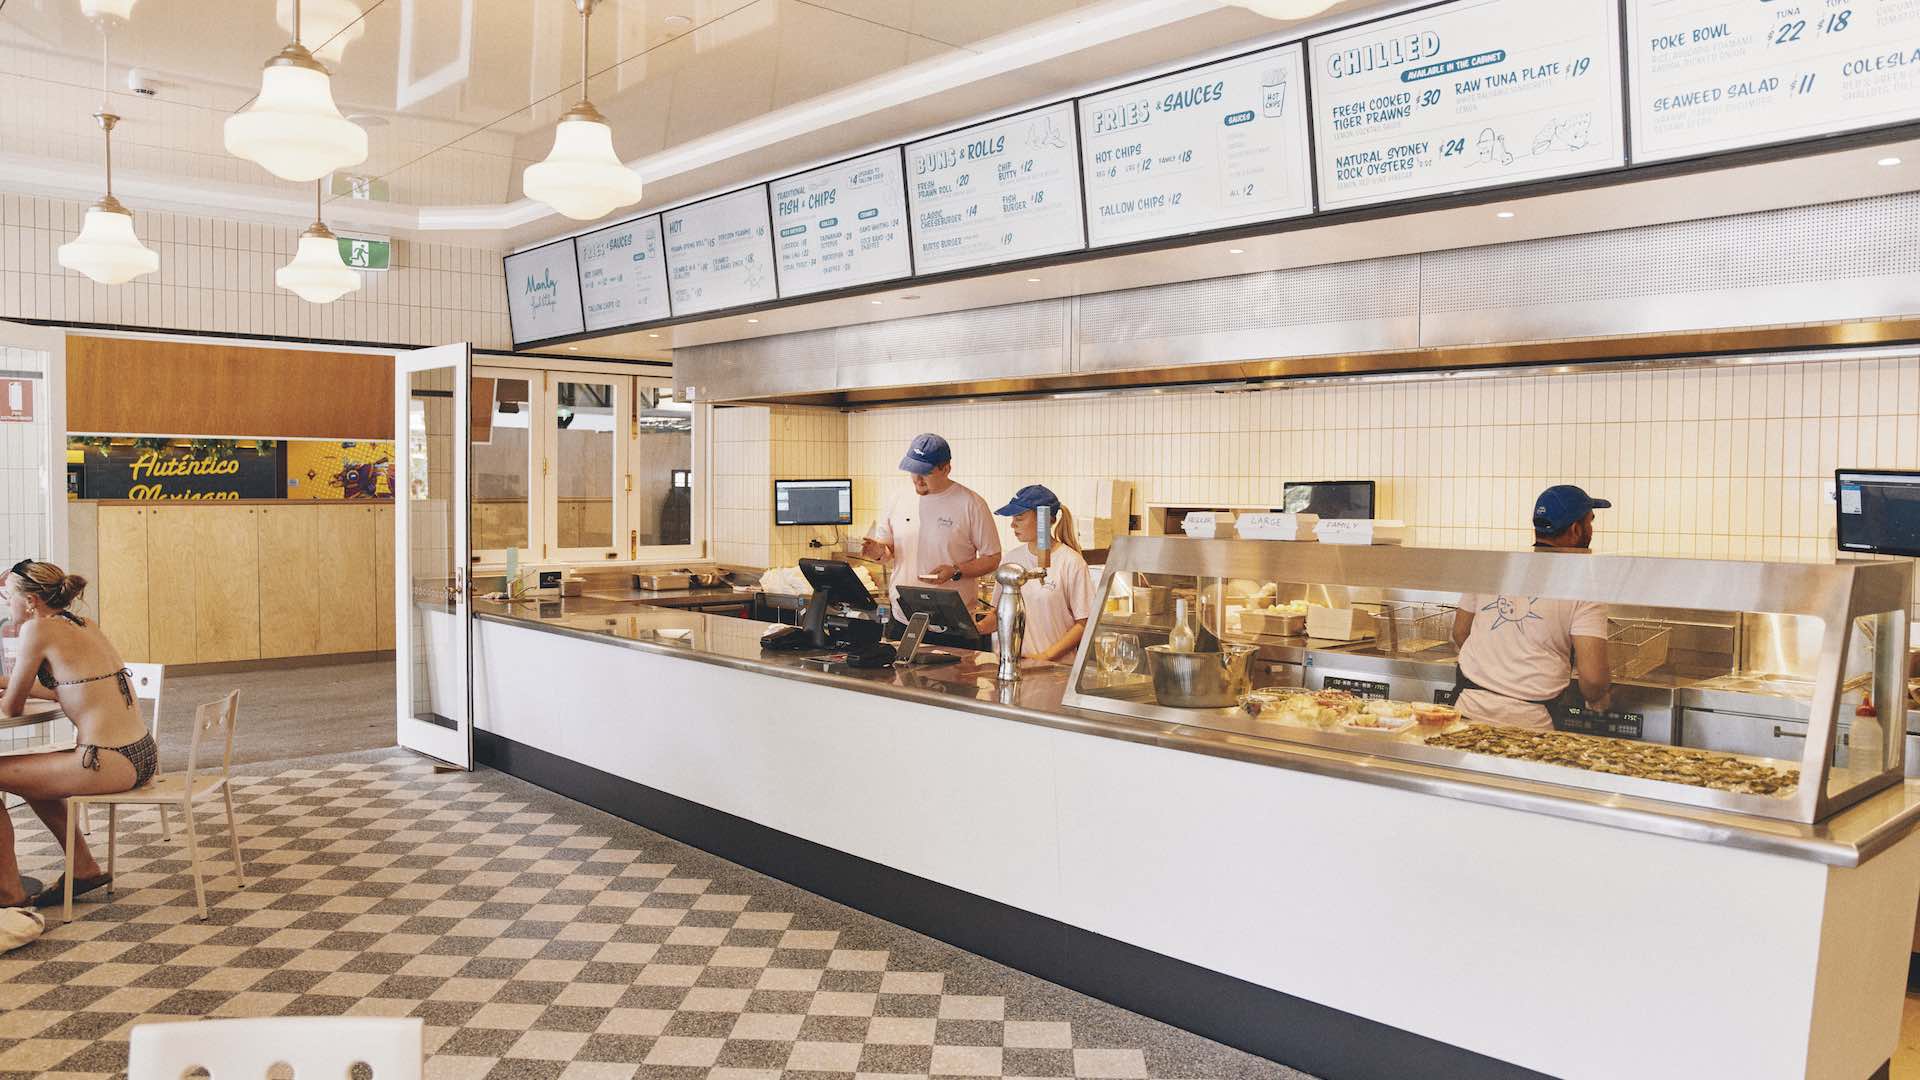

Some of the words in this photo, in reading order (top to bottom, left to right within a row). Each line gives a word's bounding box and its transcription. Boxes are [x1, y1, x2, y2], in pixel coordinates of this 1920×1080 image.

[1776, 7, 1800, 18] TUNA
[1817, 9, 1853, 35] $18
[1651, 33, 1686, 51] POKE
[1692, 23, 1732, 42] BOWL
[1767, 20, 1806, 46] $22
[1327, 30, 1440, 80] CHILLED
[1407, 64, 1445, 80] AVAILABLE
[1446, 62, 1455, 72] IN
[1456, 59, 1470, 69] THE
[1471, 52, 1503, 66] CABINET
[1455, 77, 1481, 95] RAW
[1484, 71, 1518, 88] TUNA
[1521, 62, 1560, 80] PLATE
[1565, 57, 1591, 79] $19
[1790, 73, 1816, 97] $11
[1333, 101, 1366, 118] FRESH
[1369, 92, 1411, 111] COOKED
[1416, 88, 1441, 109] $30
[1653, 88, 1722, 112] SEAWEED
[1727, 76, 1779, 98] SALAD
[1093, 99, 1150, 134] FRIES
[1163, 81, 1225, 112] SAUCES
[1333, 115, 1362, 131] TIGER
[1366, 105, 1411, 125] PRAWNS
[917, 148, 957, 175] BUNS
[960, 147, 966, 160] &
[968, 136, 1005, 160] ROLLS
[1096, 150, 1112, 164] HOT
[1115, 143, 1142, 160] CHIPS
[1336, 150, 1383, 169] NATURAL
[1387, 141, 1429, 160] SYDNEY
[1439, 138, 1465, 160] $24
[1337, 166, 1363, 181] ROCK
[1367, 157, 1414, 176] OYSTERS
[779, 198, 799, 217] FISH
[808, 188, 836, 210] CHIPS
[1099, 200, 1135, 216] TALLOW
[1137, 194, 1164, 210] CHIPS
[525, 267, 559, 296] Manly
[129, 452, 240, 480] Auténtico
[1250, 517, 1281, 528] LARGE
[1326, 520, 1360, 529] FAMILY
